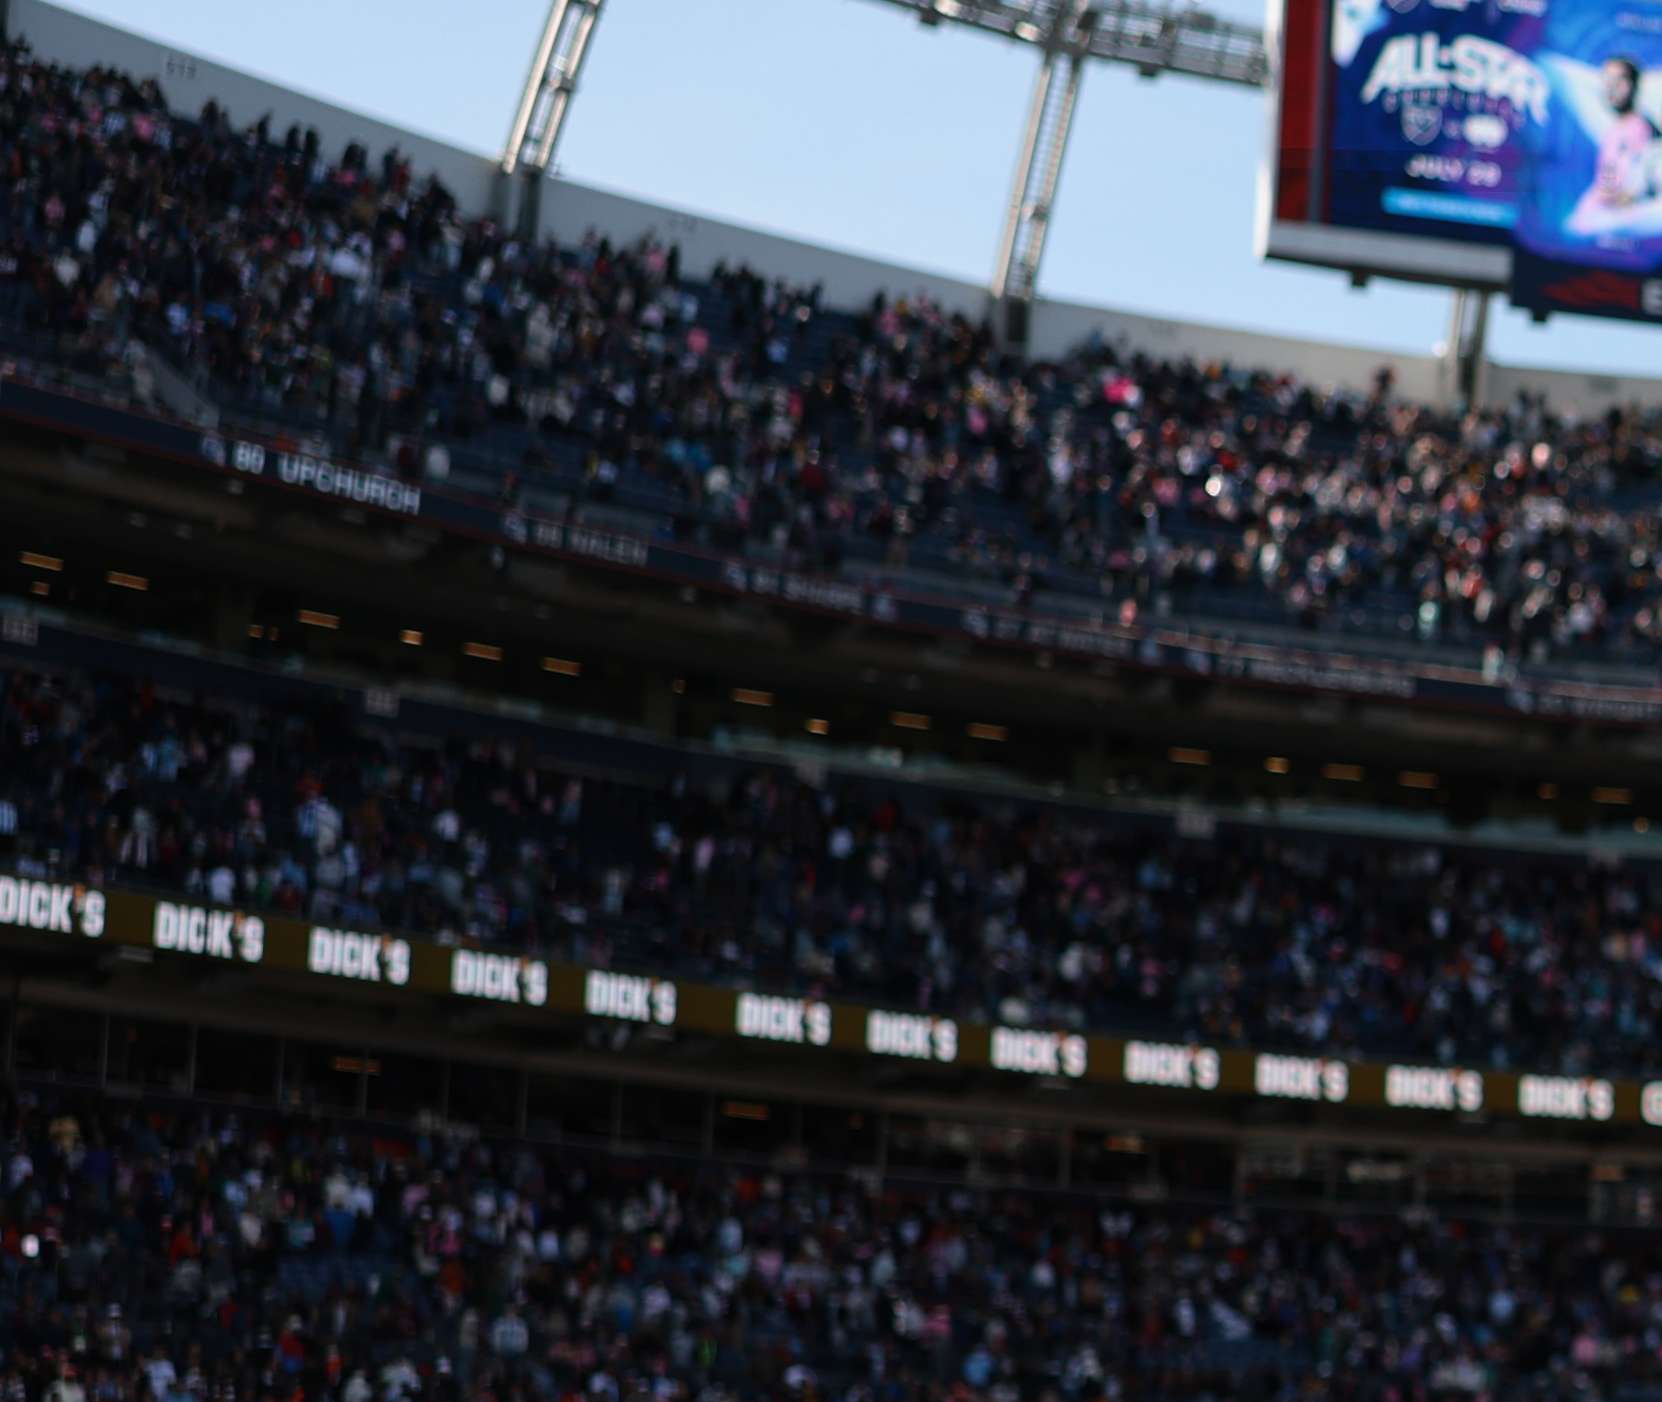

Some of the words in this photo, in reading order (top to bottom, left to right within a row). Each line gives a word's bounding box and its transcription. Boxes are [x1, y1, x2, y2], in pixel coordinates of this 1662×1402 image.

[1405, 154, 1464, 182] JULY
[0, 876, 105, 937] DICK'S
[154, 901, 264, 962] DICK'S
[309, 926, 410, 985] DICK'S
[452, 949, 548, 1005] DICK'S
[585, 970, 676, 1024] DICK'S
[737, 992, 831, 1045] DICK'S
[867, 1010, 957, 1061] DICK'S
[991, 1026, 1086, 1077] DICK'S
[1124, 1041, 1219, 1090] DICK'S
[1255, 1053, 1348, 1101] DICK'S
[1385, 1065, 1482, 1111] DICK'S
[1519, 1074, 1613, 1121] DICK'S
